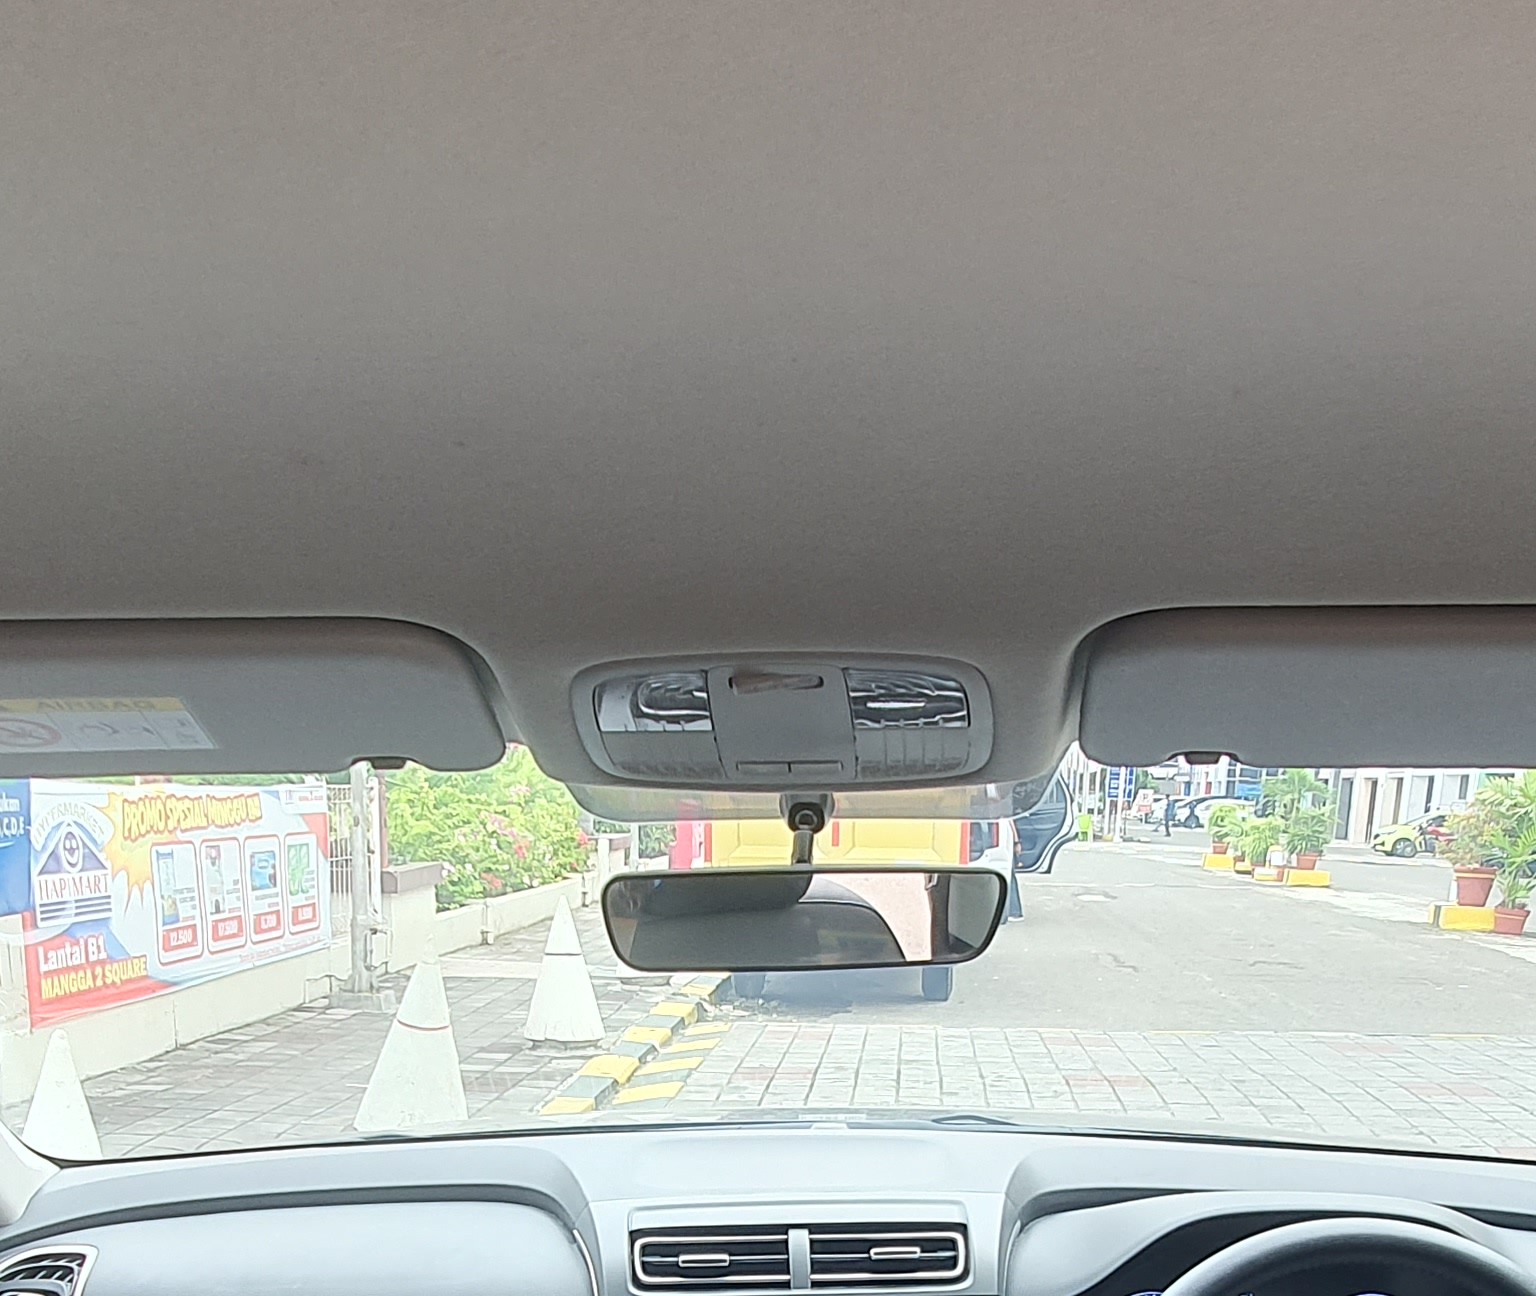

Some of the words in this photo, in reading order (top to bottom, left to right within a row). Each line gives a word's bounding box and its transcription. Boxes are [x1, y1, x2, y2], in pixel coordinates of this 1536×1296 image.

[123, 796, 164, 841] PROMO
[165, 794, 207, 833] SPESIAL
[38, 873, 109, 901] HAPIMART
[37, 938, 86, 972] Lantai
[41, 968, 95, 999] MANGGA
[95, 966, 104, 986] 2
[105, 956, 147, 986] SQUARE
